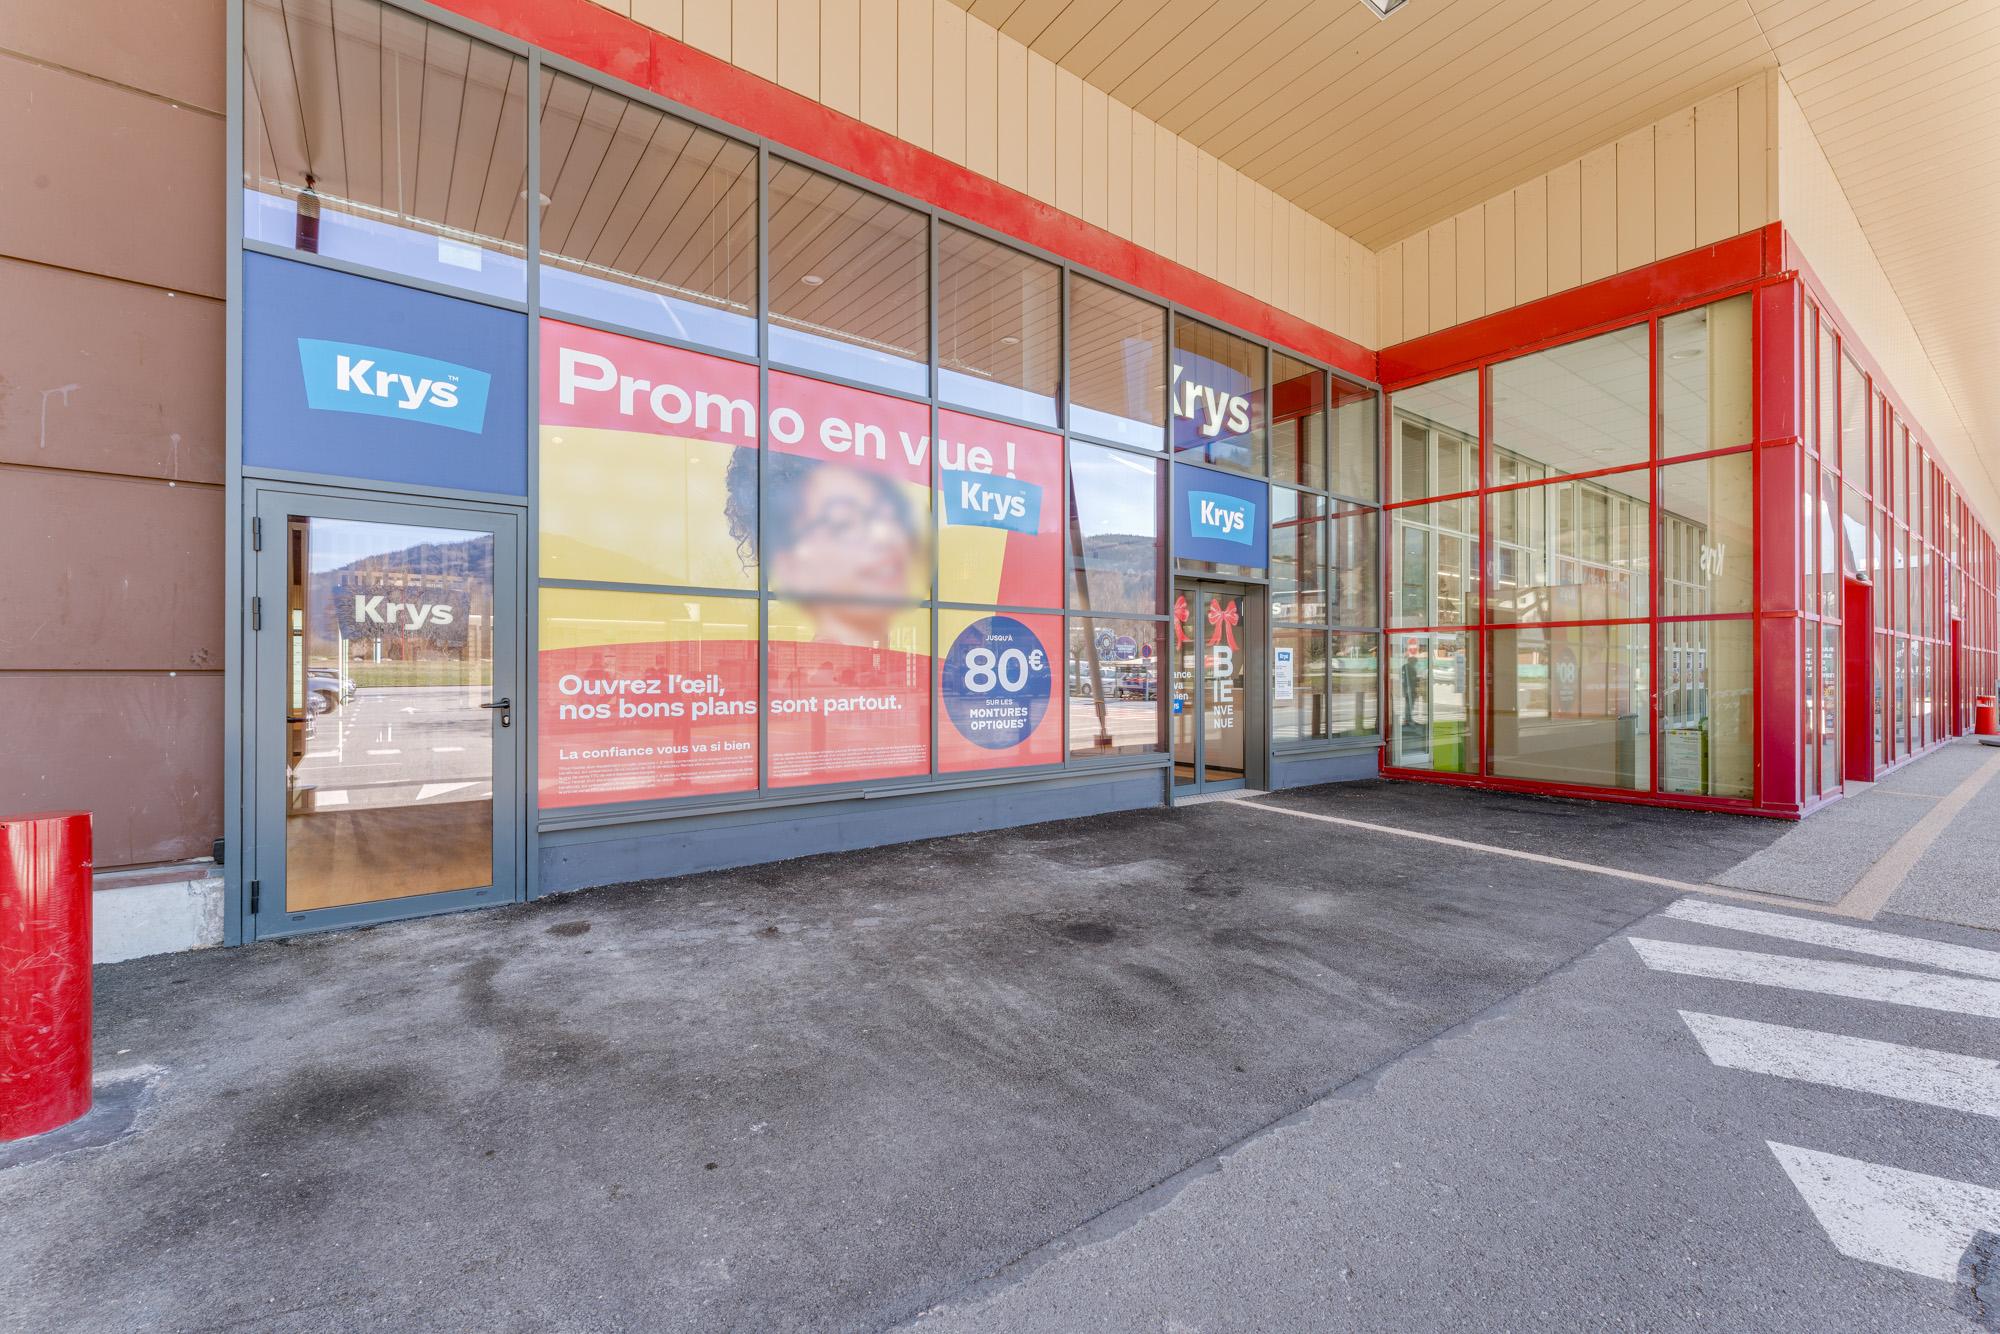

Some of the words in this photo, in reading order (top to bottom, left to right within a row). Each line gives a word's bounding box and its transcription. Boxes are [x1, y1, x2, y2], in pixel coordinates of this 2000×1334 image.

[336, 354, 459, 410] Krys
[559, 347, 804, 444] Promo
[819, 416, 886, 460] en
[897, 430, 993, 475] vue
[961, 479, 1026, 521] Krys
[1200, 499, 1245, 533] Krys
[355, 594, 454, 631] Krys
[558, 674, 661, 697] Ouvrez
[964, 647, 1043, 692] 80€
[559, 701, 611, 720] nos
[619, 699, 685, 718] bons
[691, 697, 756, 721] plans
[770, 696, 818, 714] sont
[823, 694, 902, 715] partout.
[970, 707, 1028, 718] MONTURES
[559, 749, 578, 760] La
[582, 743, 654, 760] confiance
[656, 744, 689, 755] vous
[691, 744, 708, 753] va
[710, 741, 721, 751] si
[723, 740, 751, 751] bien
